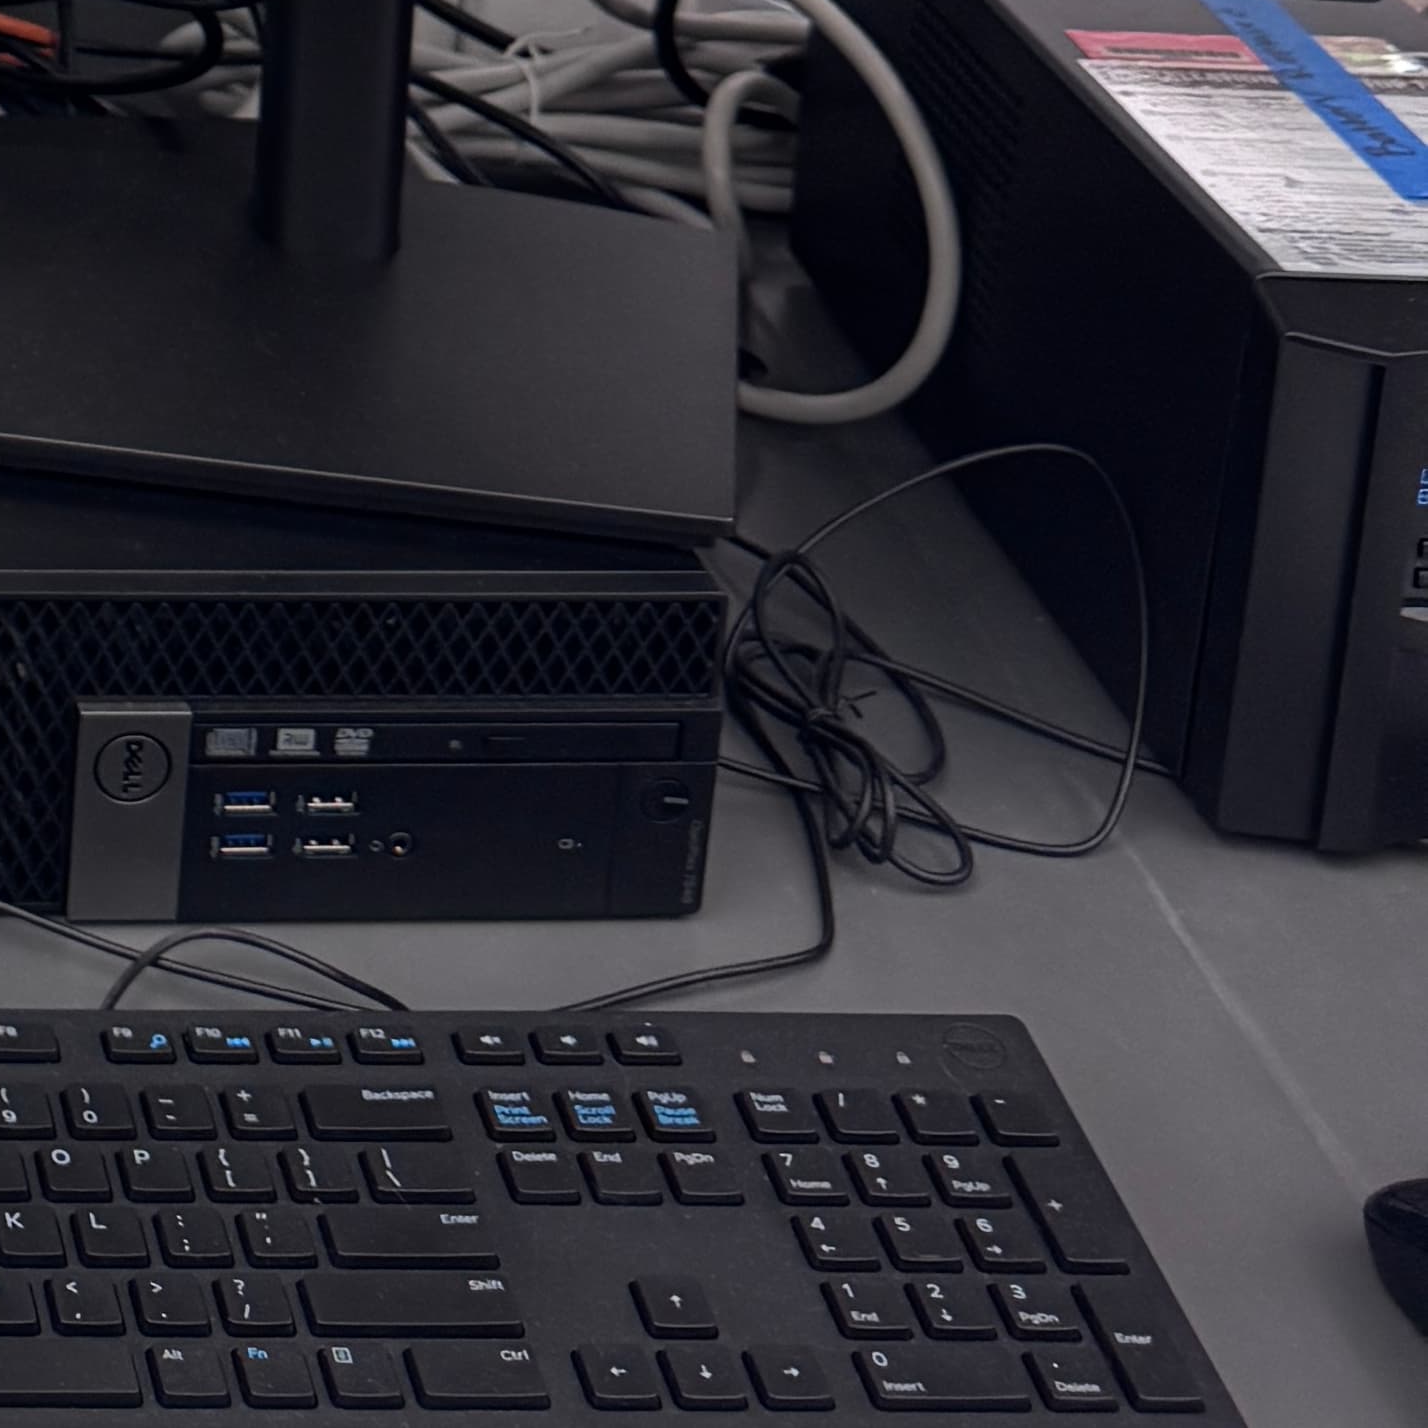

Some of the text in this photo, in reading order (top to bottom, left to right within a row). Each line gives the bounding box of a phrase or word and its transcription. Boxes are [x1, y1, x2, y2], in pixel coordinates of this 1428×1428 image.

[121, 740, 143, 794] DELL
[361, 1089, 434, 1103] Backspace
[51, 1148, 71, 1166] O
[132, 1148, 151, 1165] P
[511, 1150, 558, 1162] Delete
[4, 1211, 25, 1229] K
[88, 1211, 107, 1230] L
[439, 1213, 479, 1225] Enter
